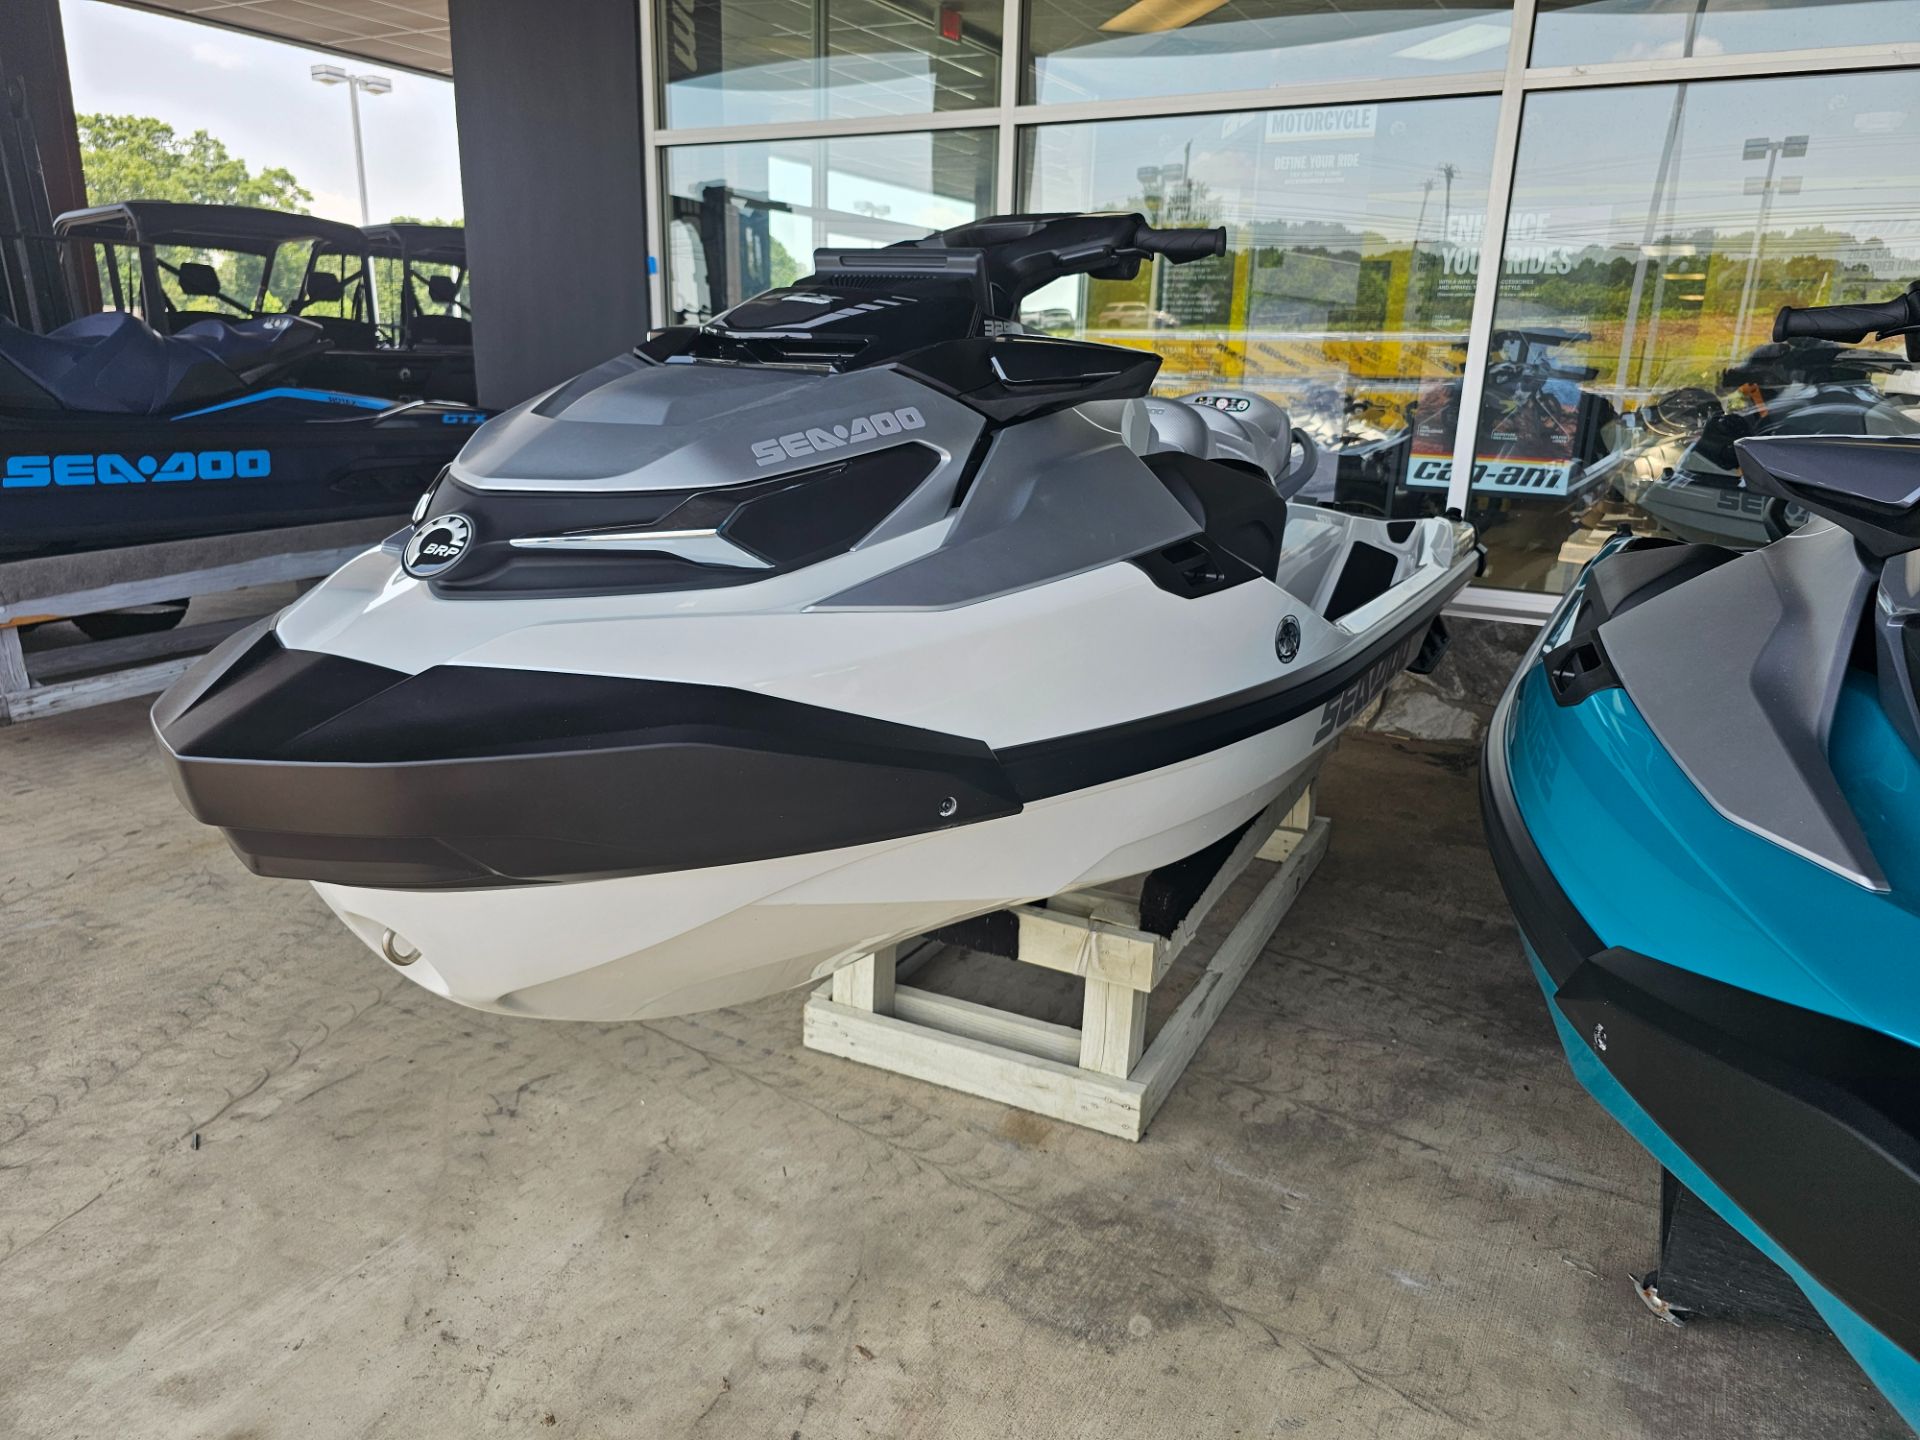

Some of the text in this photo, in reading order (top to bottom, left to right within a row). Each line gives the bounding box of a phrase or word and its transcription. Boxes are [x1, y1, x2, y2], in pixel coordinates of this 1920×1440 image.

[1271, 108, 1371, 134] MOTORCYCLE
[1274, 152, 1360, 170] DEFINE YOUR RIDE
[1447, 212, 1551, 241] ENHNCE
[1442, 246, 1574, 275] YOU RIDES
[441, 411, 487, 424] GTX
[422, 542, 460, 558] BRP
